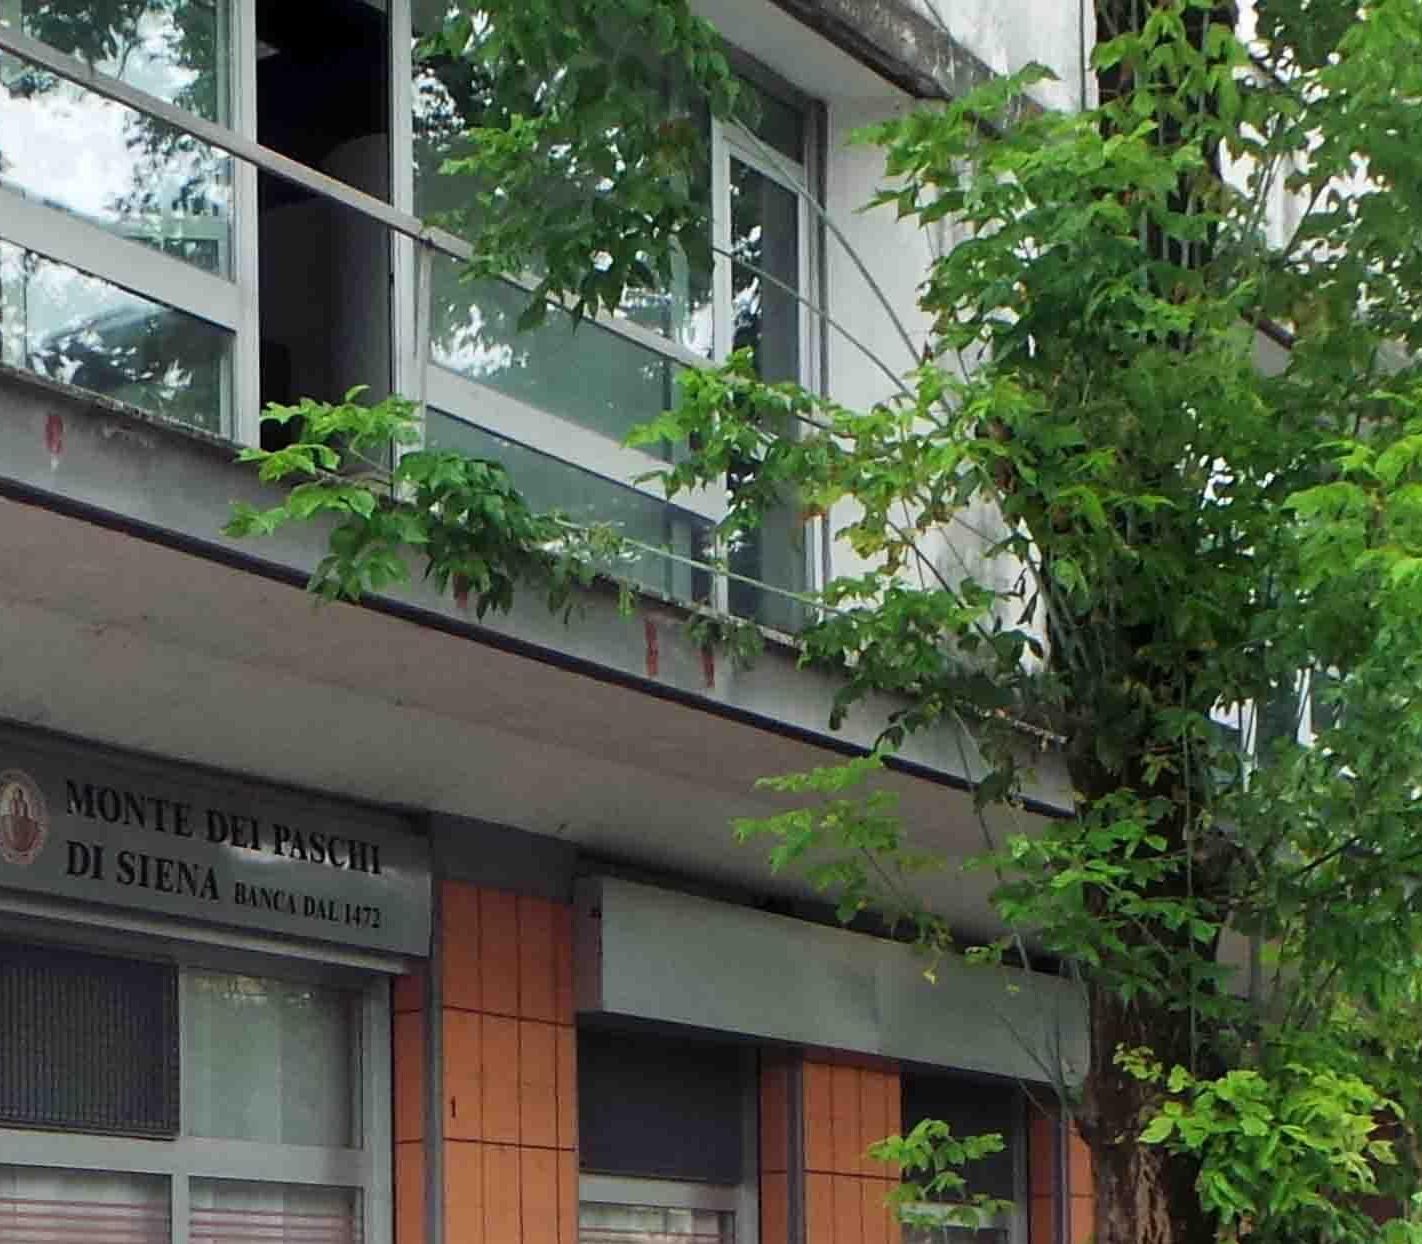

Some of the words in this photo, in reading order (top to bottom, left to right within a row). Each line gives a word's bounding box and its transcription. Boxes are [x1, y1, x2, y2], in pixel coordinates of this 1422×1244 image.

[65, 778, 194, 838] MONTE
[204, 808, 263, 851] DEI
[272, 823, 384, 875] PASCHI
[65, 840, 105, 880] DI
[115, 850, 221, 901] SIENA
[233, 881, 297, 915] BANCA
[303, 897, 338, 921] DAL
[343, 903, 382, 929] 1472
